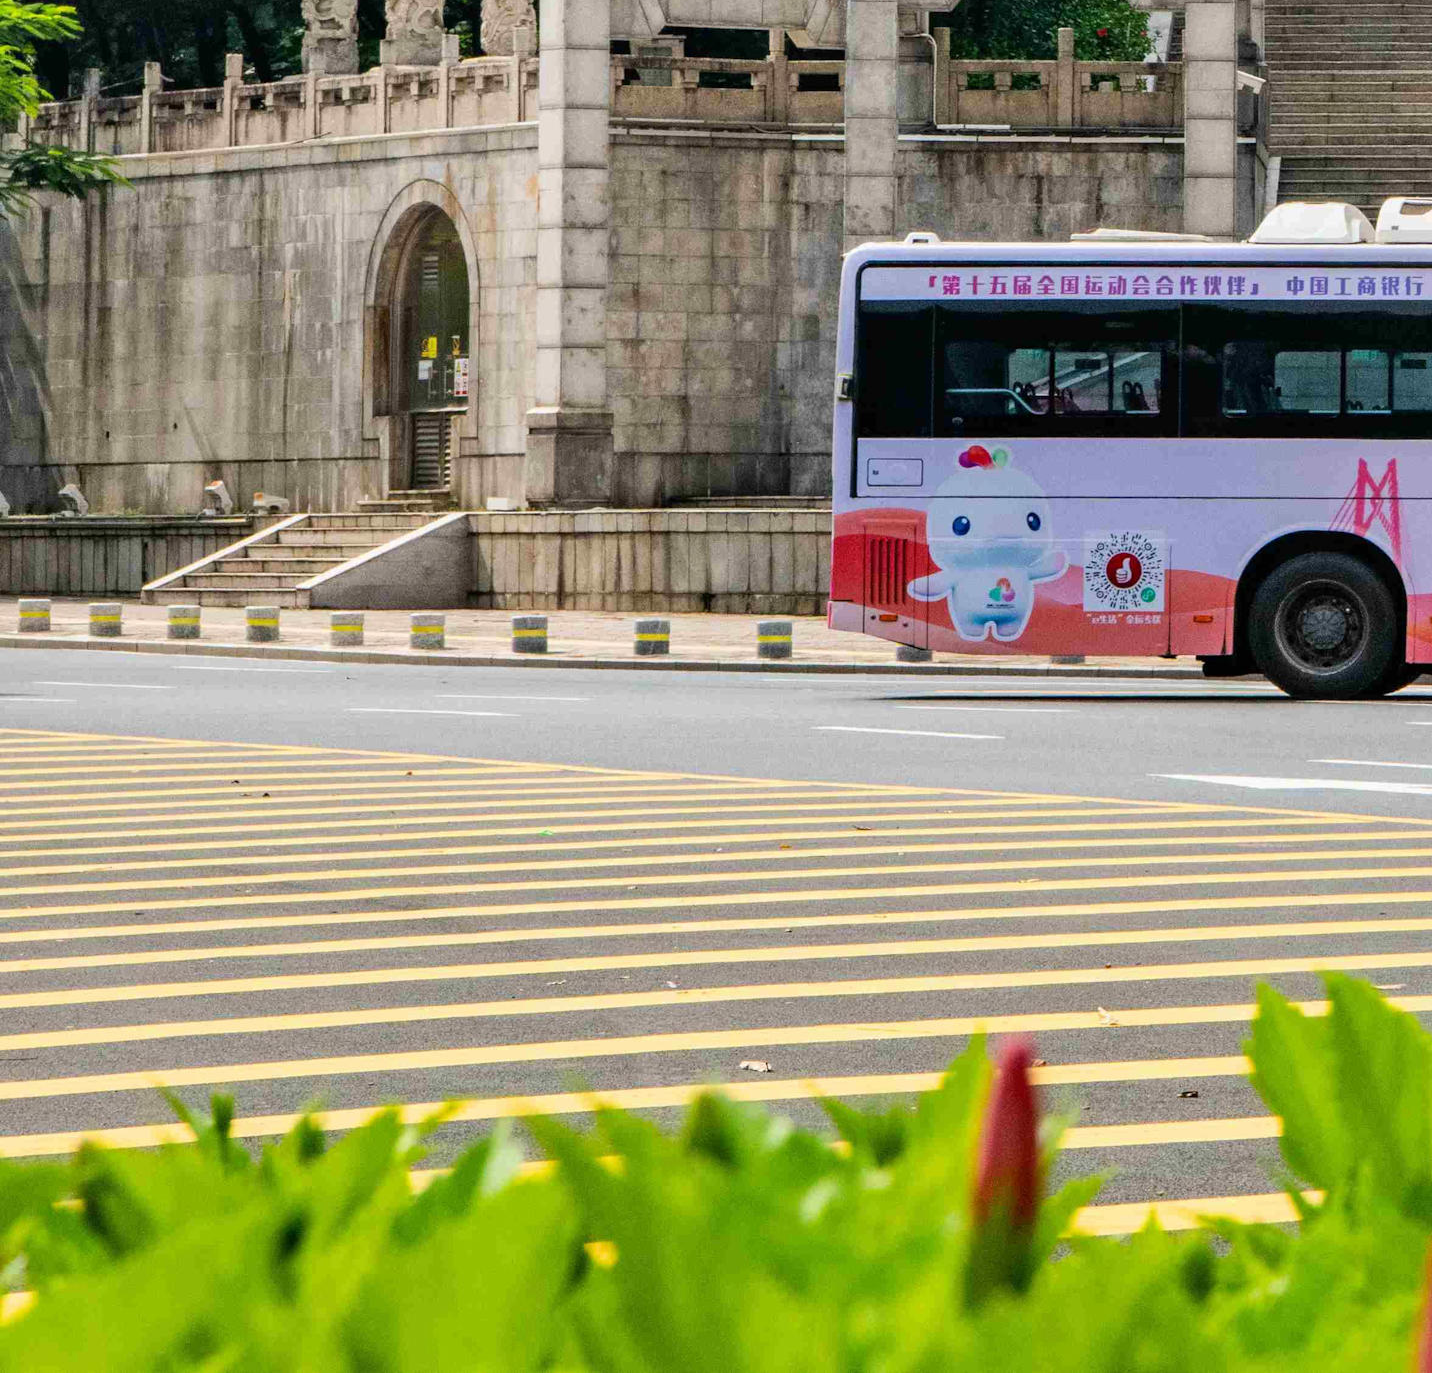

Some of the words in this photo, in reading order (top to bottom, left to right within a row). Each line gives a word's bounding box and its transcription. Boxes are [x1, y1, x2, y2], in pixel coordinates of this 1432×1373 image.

[1286, 276, 1424, 296] 中国工商银行
